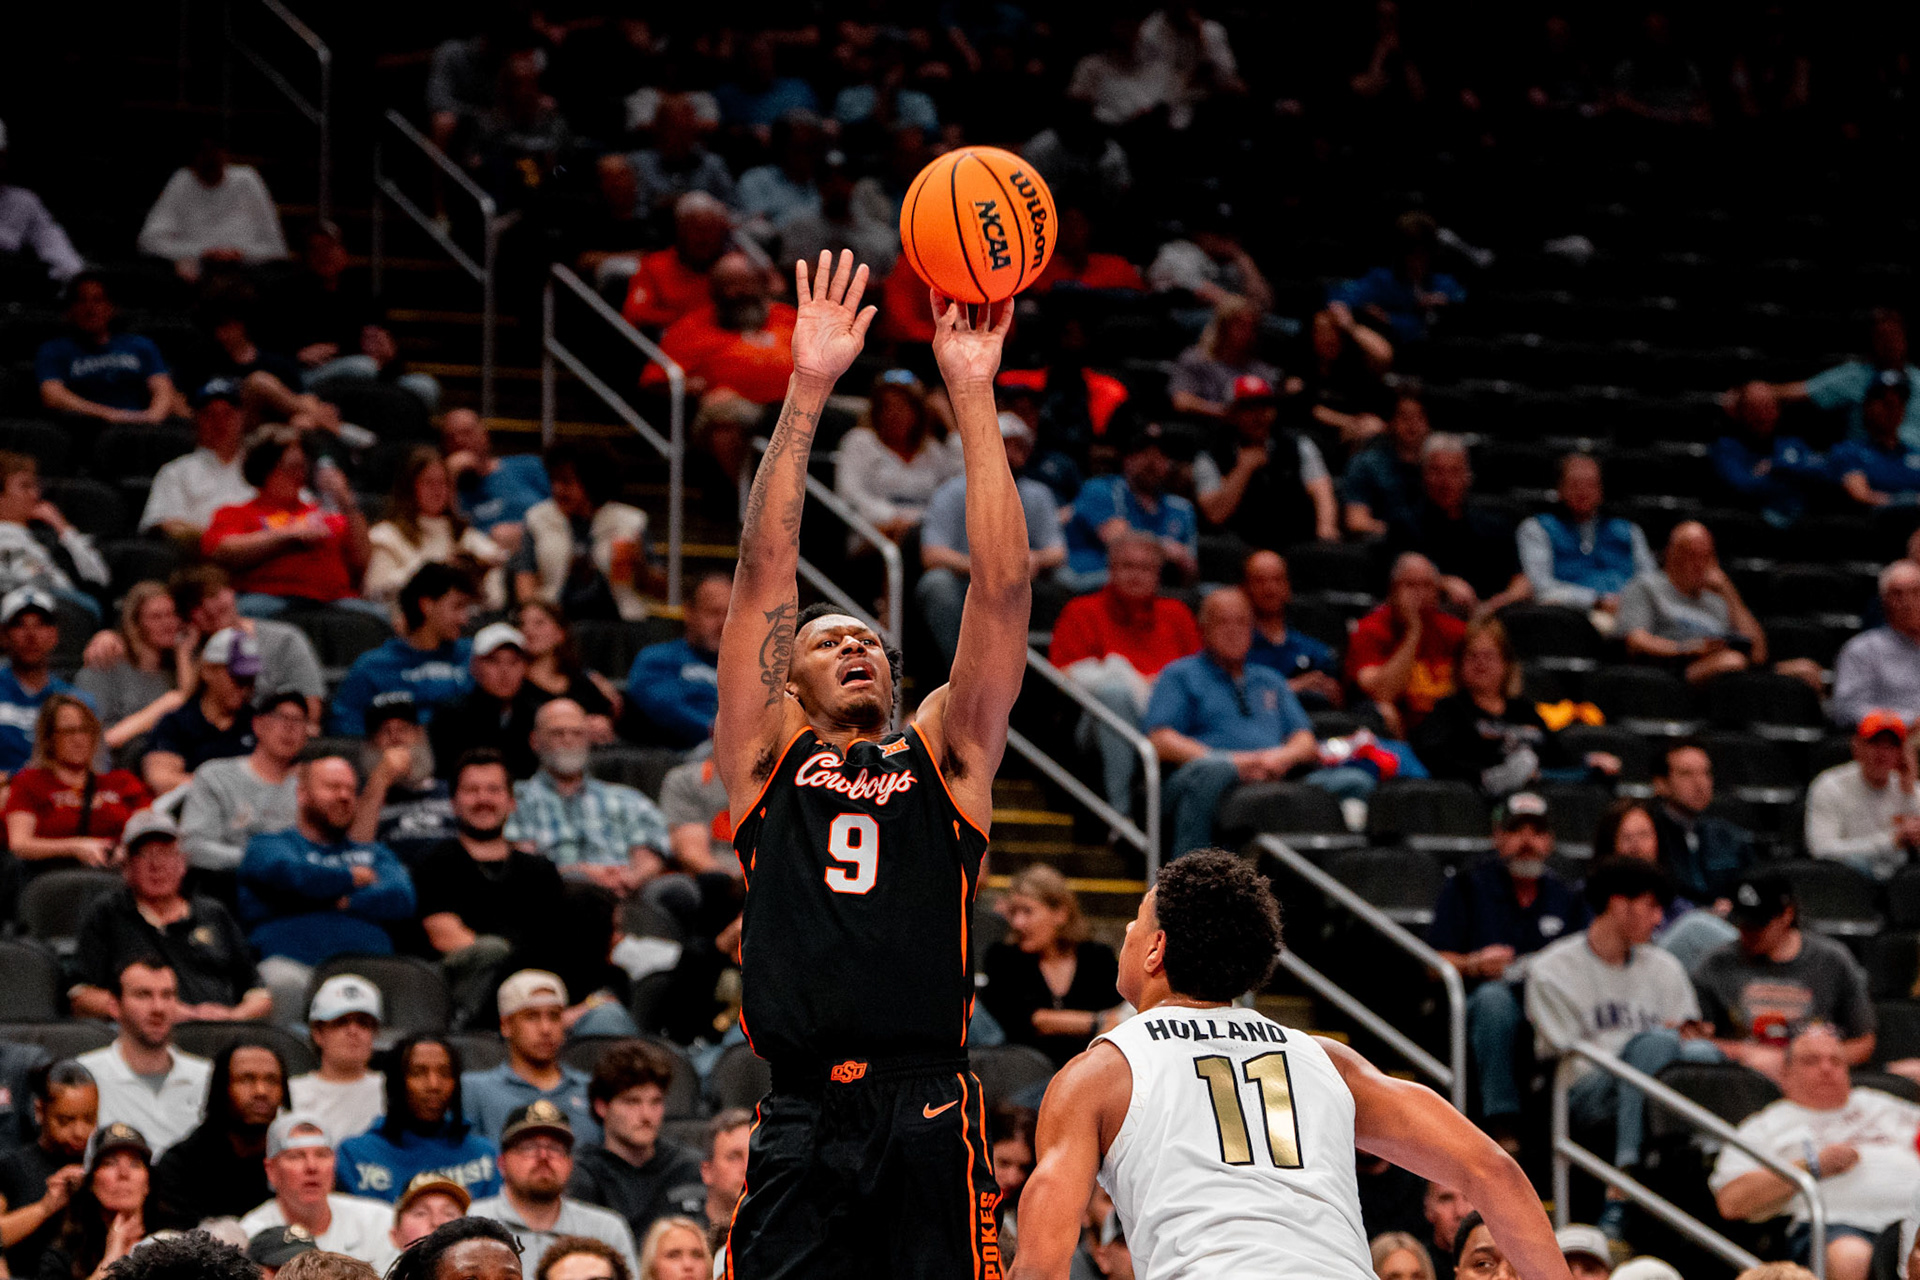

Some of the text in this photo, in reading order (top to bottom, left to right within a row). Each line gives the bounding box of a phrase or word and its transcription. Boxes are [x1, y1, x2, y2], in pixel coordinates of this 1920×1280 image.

[974, 200, 1012, 271] NCAA
[1010, 170, 1047, 273] Wilson
[794, 751, 918, 806] Cowboys
[824, 812, 880, 895] 9
[1144, 1018, 1288, 1044] HOLLAND
[830, 1060, 868, 1083] OSU
[1192, 1050, 1305, 1169] 11
[979, 1191, 1001, 1280] POKES
